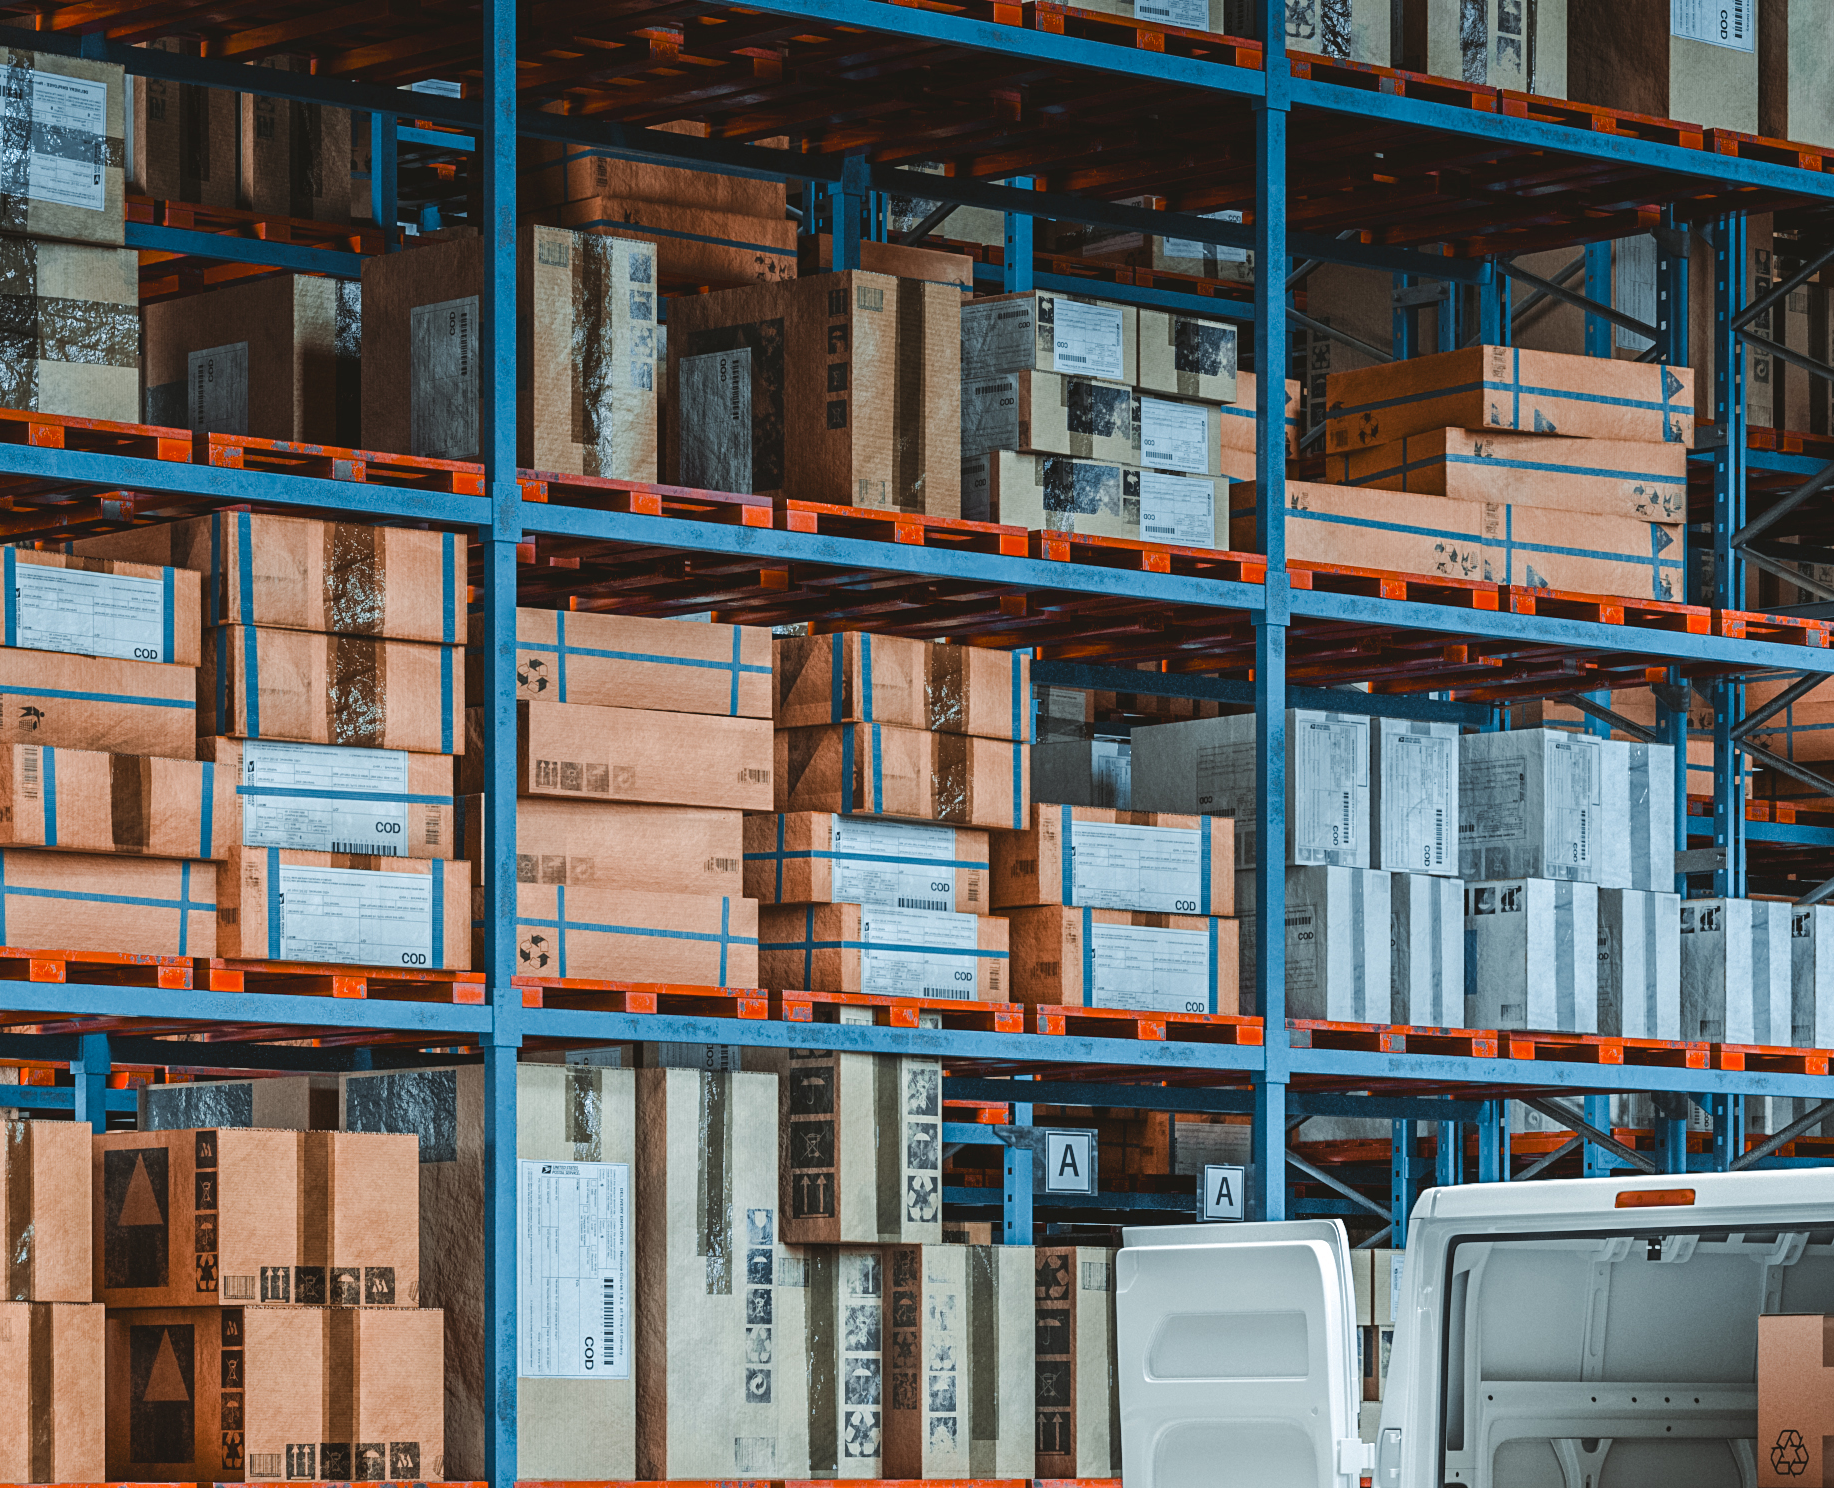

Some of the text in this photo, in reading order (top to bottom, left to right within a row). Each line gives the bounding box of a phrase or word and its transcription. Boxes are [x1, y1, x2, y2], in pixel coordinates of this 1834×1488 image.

[1720, 9, 1728, 40] COD
[999, 397, 1014, 405] COD
[133, 648, 158, 660] COD
[375, 821, 400, 833] COD
[931, 882, 950, 891] COD
[1175, 900, 1196, 911] COD
[401, 952, 426, 964] COD
[954, 971, 972, 981] COD
[1185, 1002, 1204, 1012] COD
[1058, 1143, 1079, 1177] A
[1215, 1176, 1233, 1205] A
[583, 1335, 594, 1371] COD
